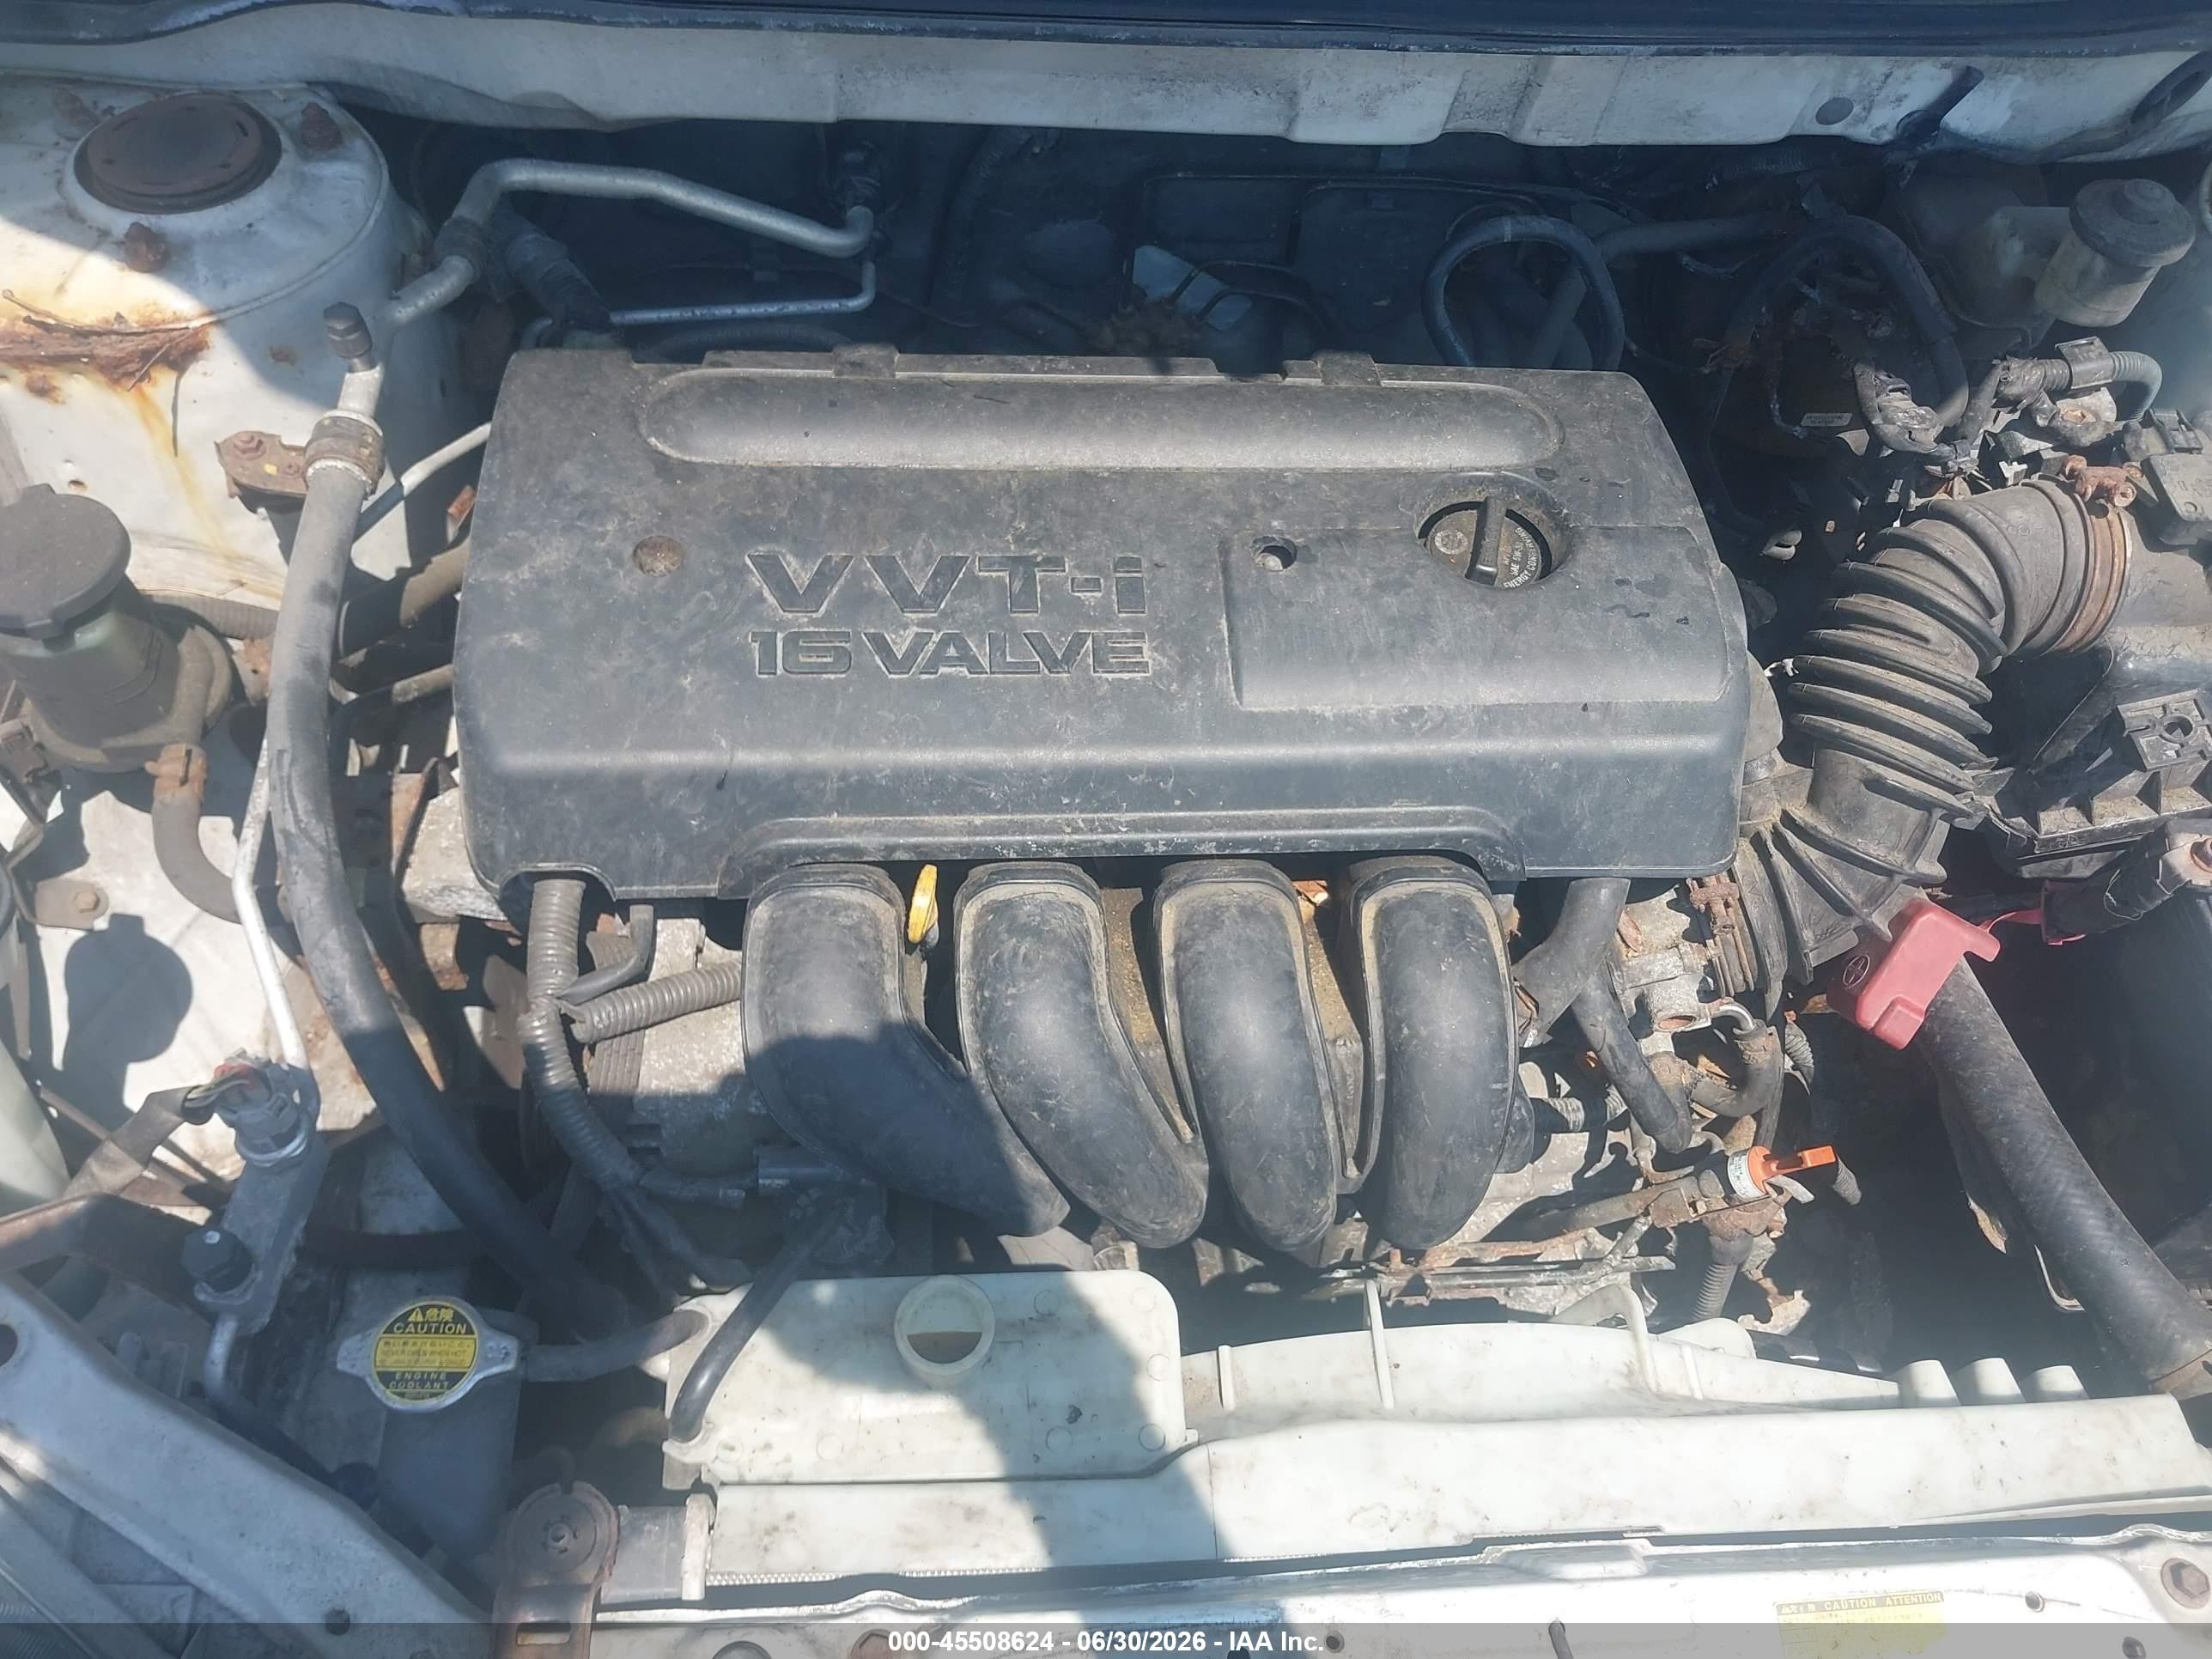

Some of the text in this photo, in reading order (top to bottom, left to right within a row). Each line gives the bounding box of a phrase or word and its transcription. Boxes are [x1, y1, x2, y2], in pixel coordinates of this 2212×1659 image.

[1510, 562, 1520, 576] SAE
[745, 553, 1147, 616] VVT-i
[1504, 570, 1532, 588] ENERGY
[749, 630, 1151, 677] 16 VALVE
[393, 1322, 467, 1334] CAUTION
[1824, 1598, 1877, 1612] CAUTION
[1885, 1592, 1942, 1607] ATTENTION
